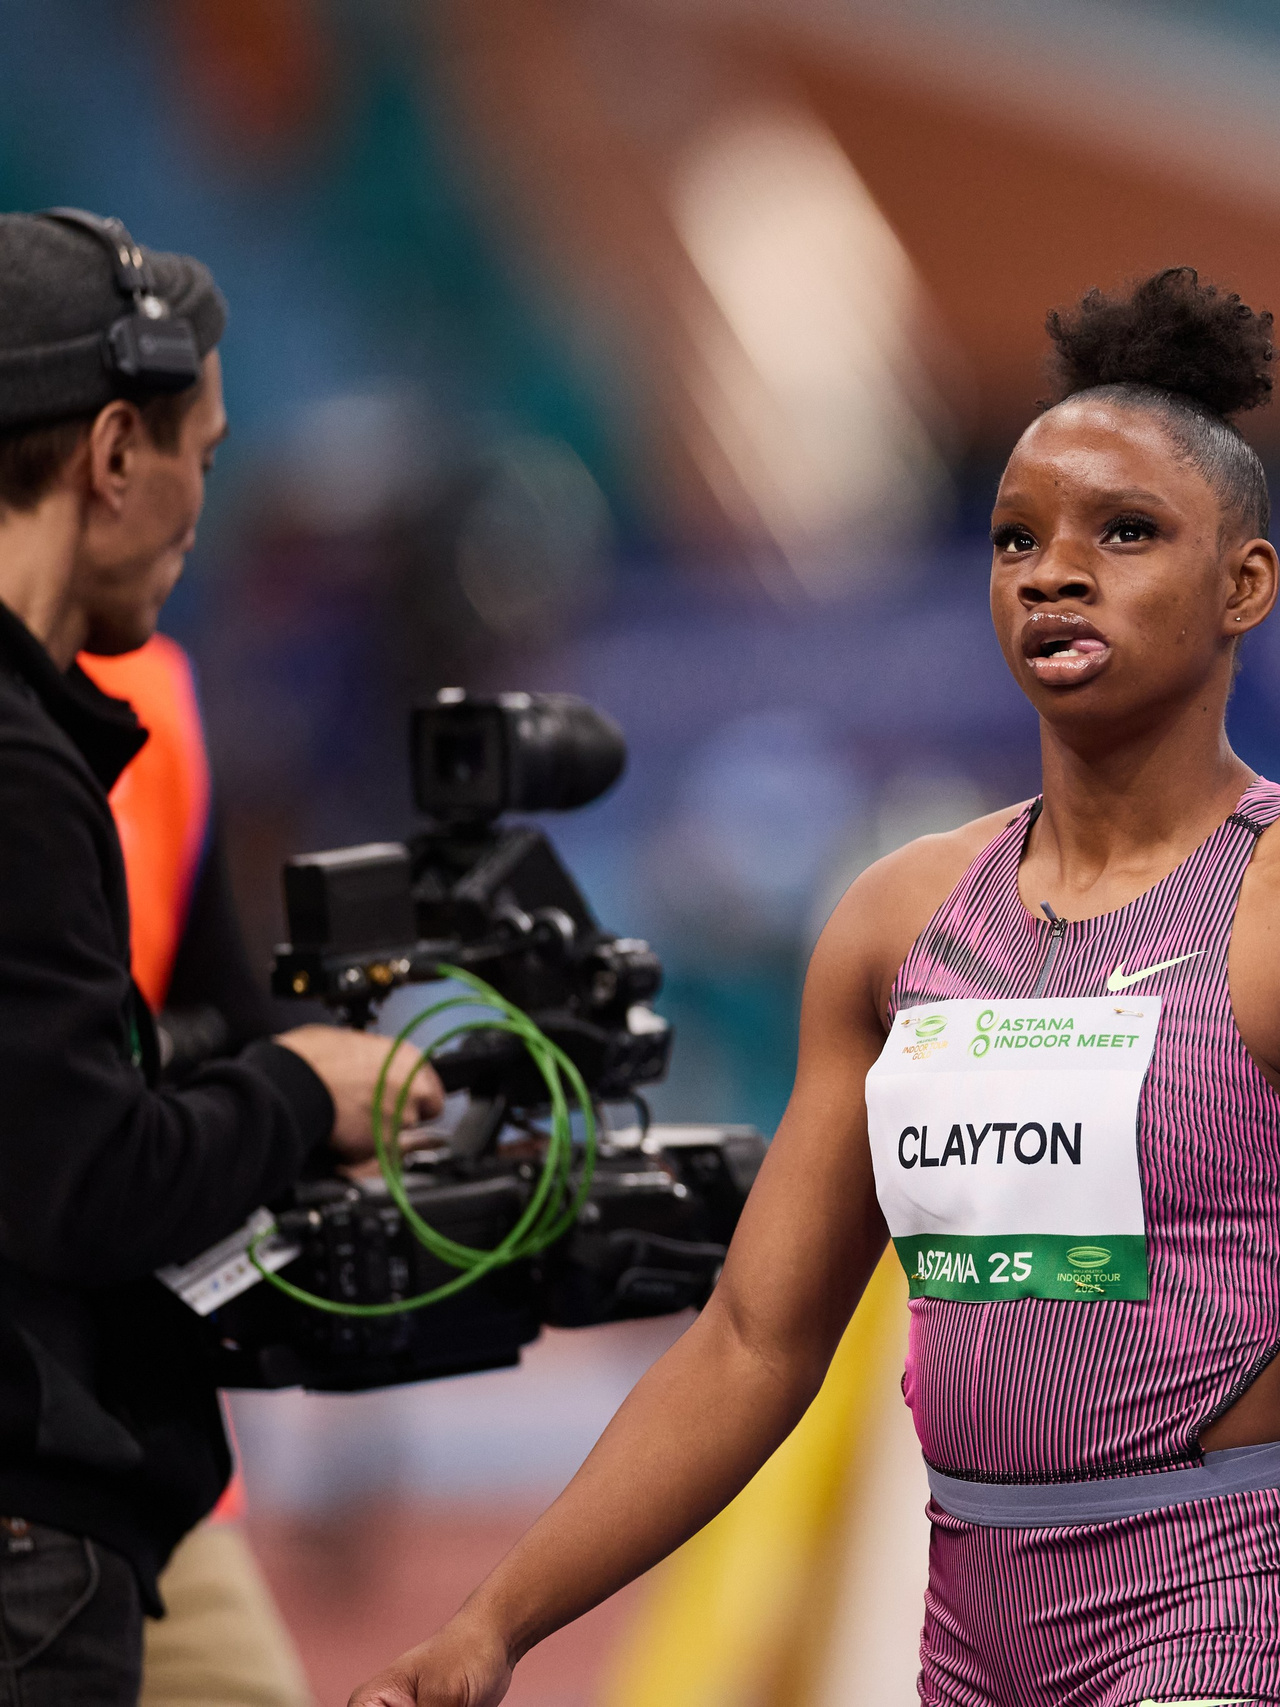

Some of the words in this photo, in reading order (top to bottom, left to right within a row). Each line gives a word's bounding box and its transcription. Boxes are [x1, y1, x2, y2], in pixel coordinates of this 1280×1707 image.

[998, 1018, 1074, 1031] ASTANA
[902, 1043, 929, 1054] INDOOR
[994, 1034, 1071, 1049] INDOOR
[1077, 1034, 1139, 1048] MEET
[898, 1121, 1082, 1169] CLAYTON
[918, 1250, 980, 1284] ASTANA
[988, 1251, 1033, 1283] 25
[1057, 1273, 1092, 1283] INDOOR
[1093, 1273, 1121, 1282] TOUR
